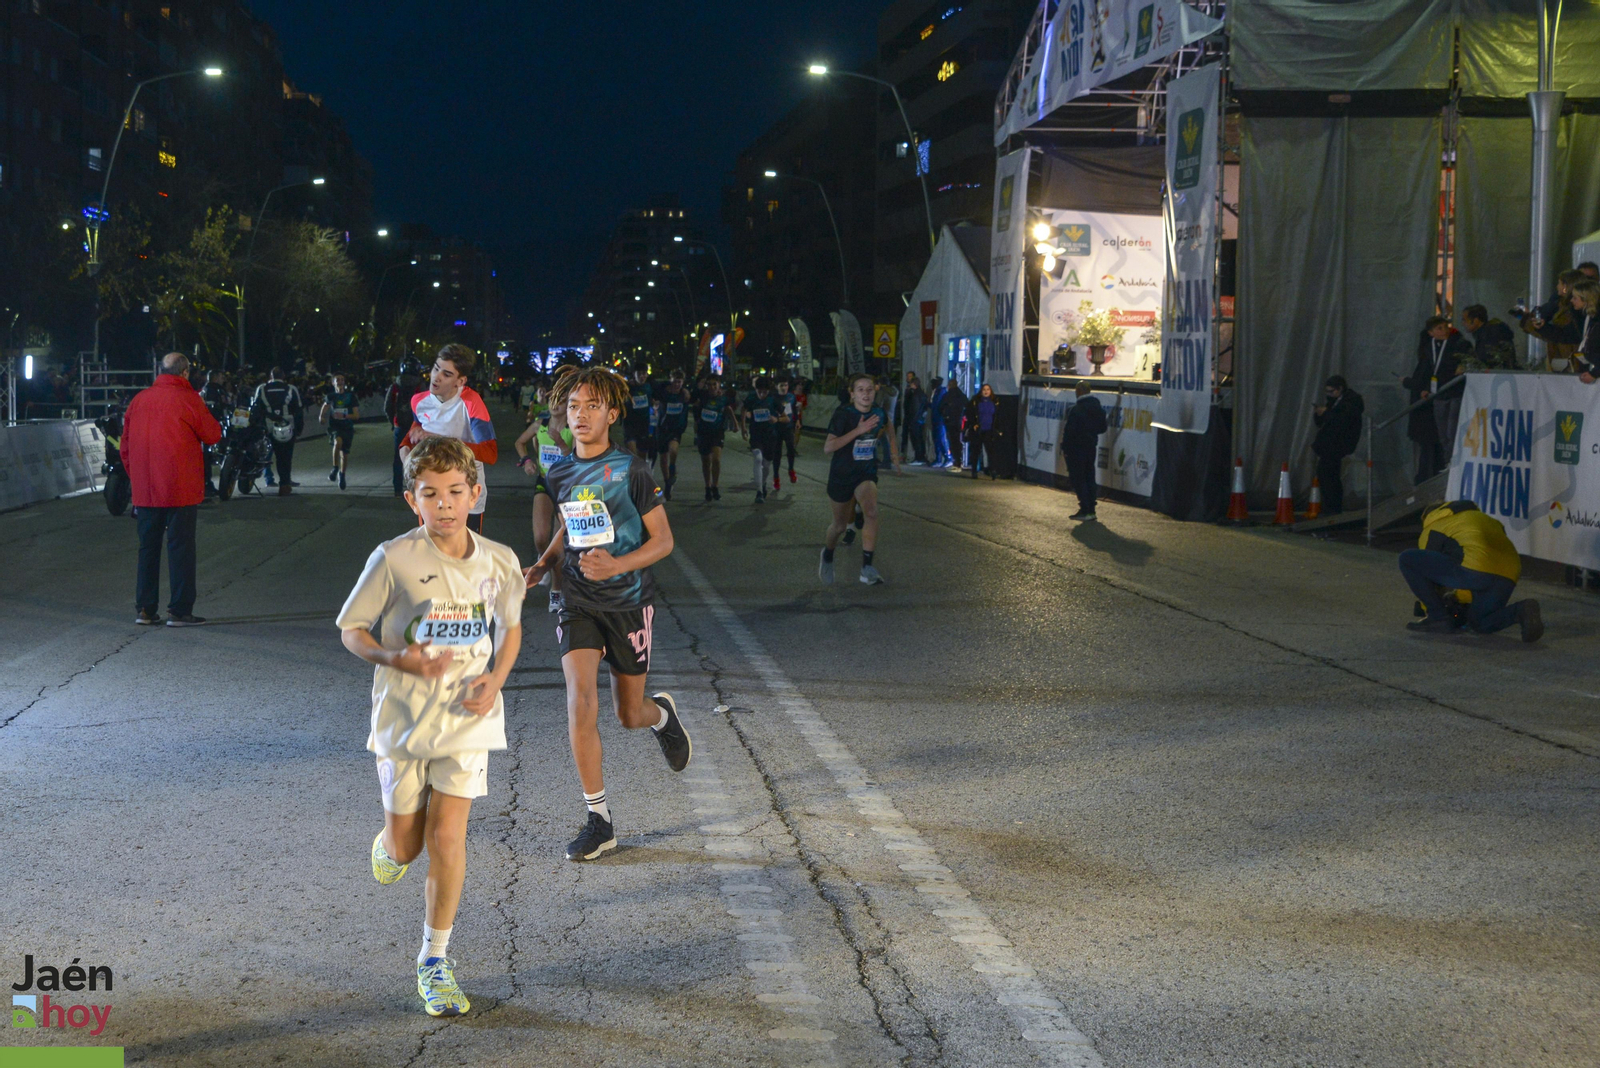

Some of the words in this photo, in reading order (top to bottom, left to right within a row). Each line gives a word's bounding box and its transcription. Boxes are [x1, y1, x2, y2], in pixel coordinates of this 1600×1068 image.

[1103, 236, 1152, 251] calderón
[1463, 407, 1488, 458] 41
[1490, 409, 1534, 462] SAN
[1460, 460, 1531, 520] ANTÓN
[571, 515, 605, 531] 13046
[427, 612, 440, 620] AN
[424, 622, 483, 638] 12393
